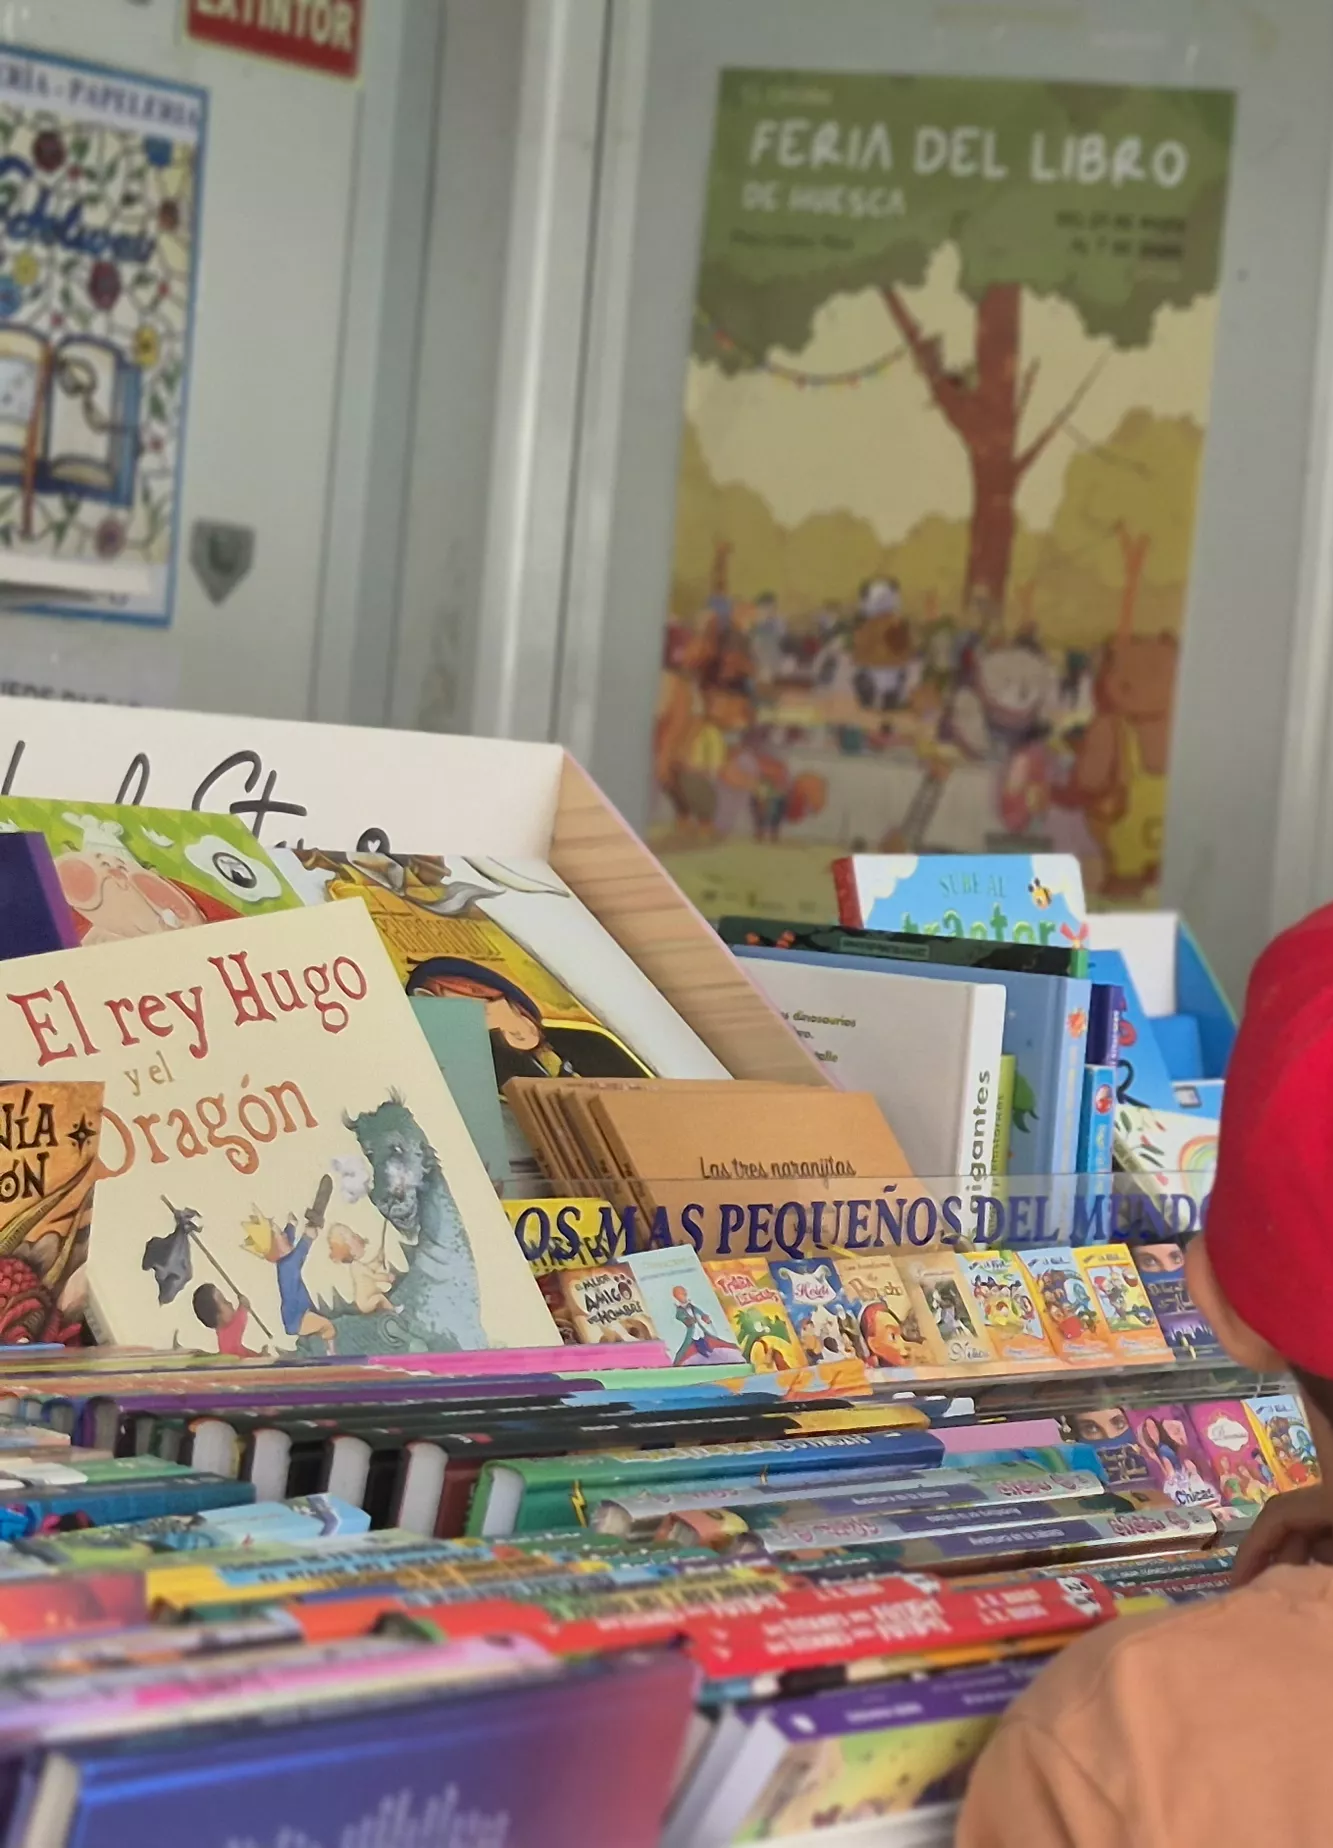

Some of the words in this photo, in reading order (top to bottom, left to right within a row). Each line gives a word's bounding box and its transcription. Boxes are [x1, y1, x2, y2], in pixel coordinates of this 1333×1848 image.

[197, 0, 354, 52] EXTINTOR
[748, 115, 894, 174] FERIA
[914, 125, 1010, 180] DEL
[1031, 131, 1188, 190] LIBRO
[741, 180, 780, 212] DE
[786, 182, 907, 219] HUESCA
[939, 873, 980, 898] SUBE
[988, 874, 1007, 898] AL
[7, 980, 102, 1067] El
[105, 983, 210, 1059] rey
[208, 950, 369, 1034] Hugo
[792, 1010, 856, 1028] dinosaurios
[123, 1069, 144, 1096] y
[148, 1051, 175, 1085] el
[99, 1073, 319, 1182] Dragón
[700, 1155, 733, 1180] Las
[731, 1156, 769, 1179] tres
[770, 1155, 857, 1191] naranjitas
[505, 1205, 581, 1262] OS
[598, 1203, 706, 1259] MAS
[716, 1184, 964, 1261] PEQUEÑOS
[972, 1195, 1060, 1245] DEL
[584, 1281, 633, 1313] AMIGO
[1175, 1488, 1215, 1506] Chicas
